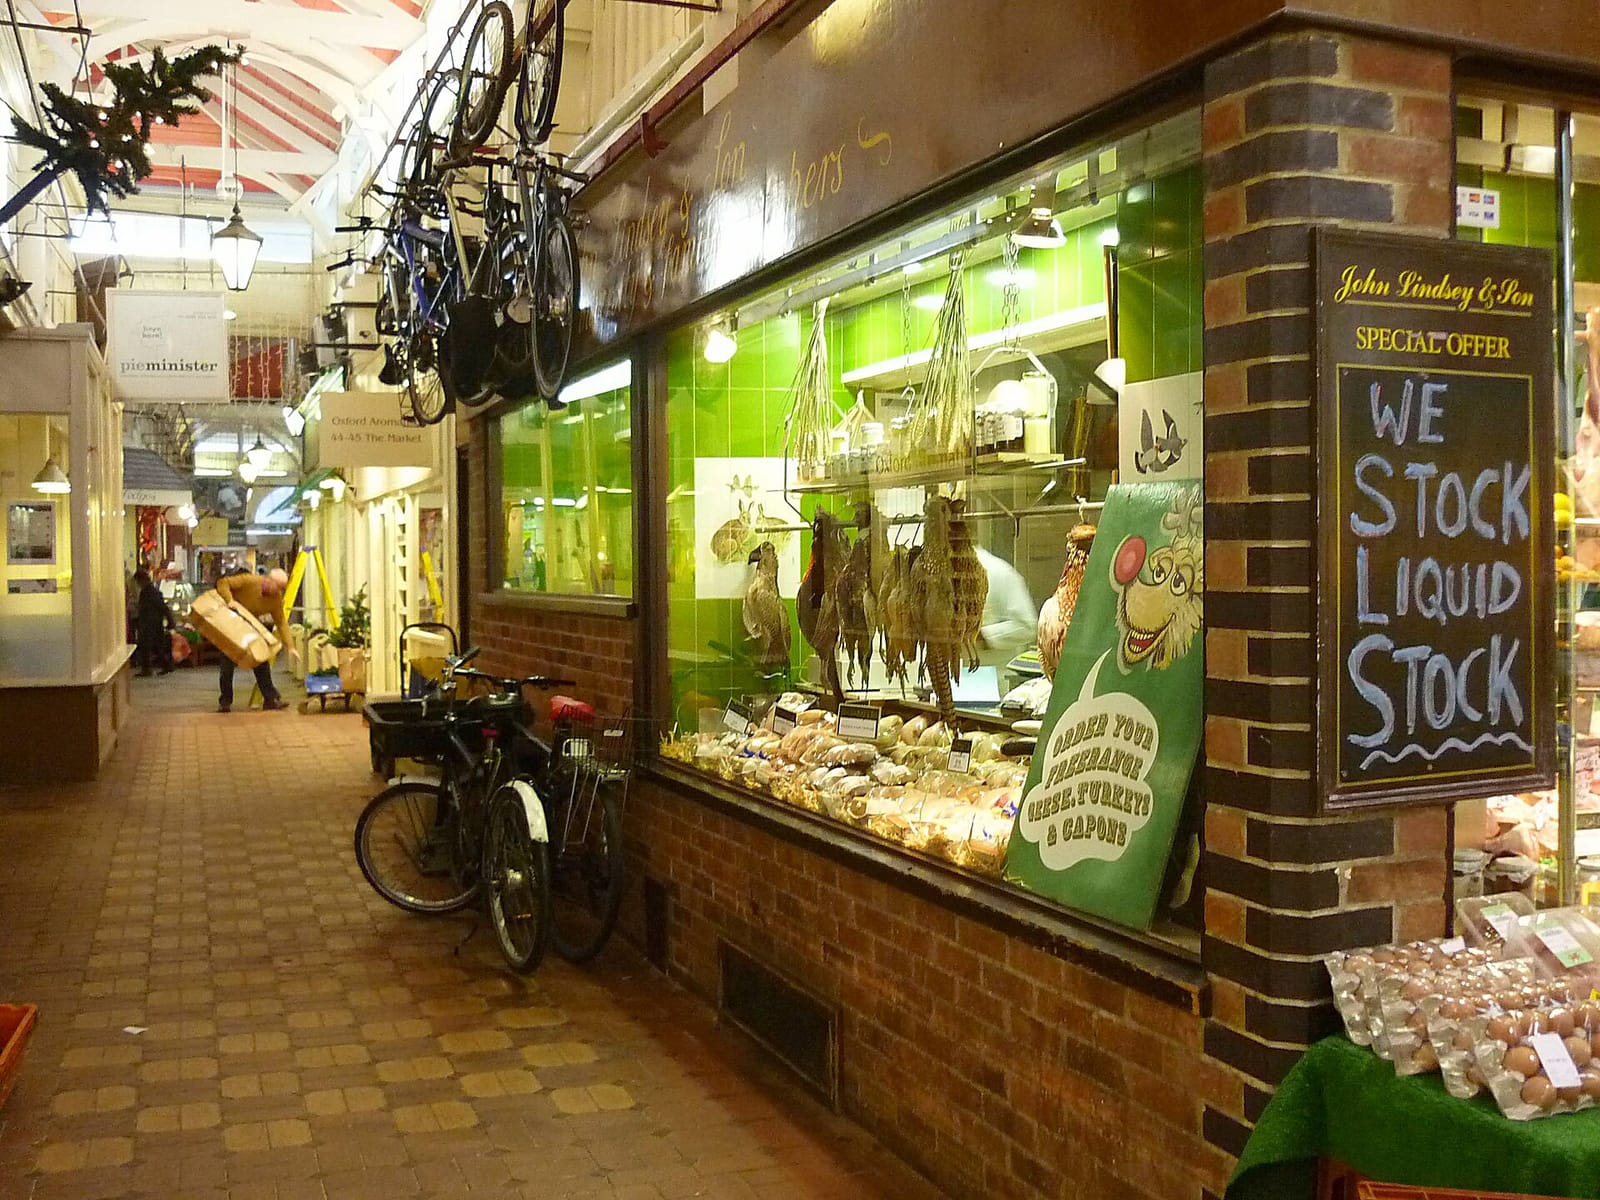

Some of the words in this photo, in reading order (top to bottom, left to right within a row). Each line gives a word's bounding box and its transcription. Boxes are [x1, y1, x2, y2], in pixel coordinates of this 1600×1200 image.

[1334, 265, 1391, 304] John
[1396, 269, 1474, 312] Lindsey
[1479, 277, 1497, 310] &
[1497, 278, 1534, 307] Son
[1356, 326, 1442, 354] SPECIAL
[1446, 333, 1511, 359] OFFER
[120, 358, 218, 373] pieminister
[332, 416, 366, 426] Oxford
[1370, 379, 1448, 446] WE
[366, 433, 385, 443] The
[388, 434, 422, 444] Market
[1351, 453, 1531, 545] STOCK
[1357, 544, 1522, 627] LIQUID
[1347, 633, 1524, 749] STOCK
[1053, 713, 1108, 758] ORDER
[1113, 713, 1154, 751] YOUR
[1045, 747, 1143, 790] FREERANGE
[1047, 824, 1057, 846] &
[1063, 815, 1128, 847] CAPONS
